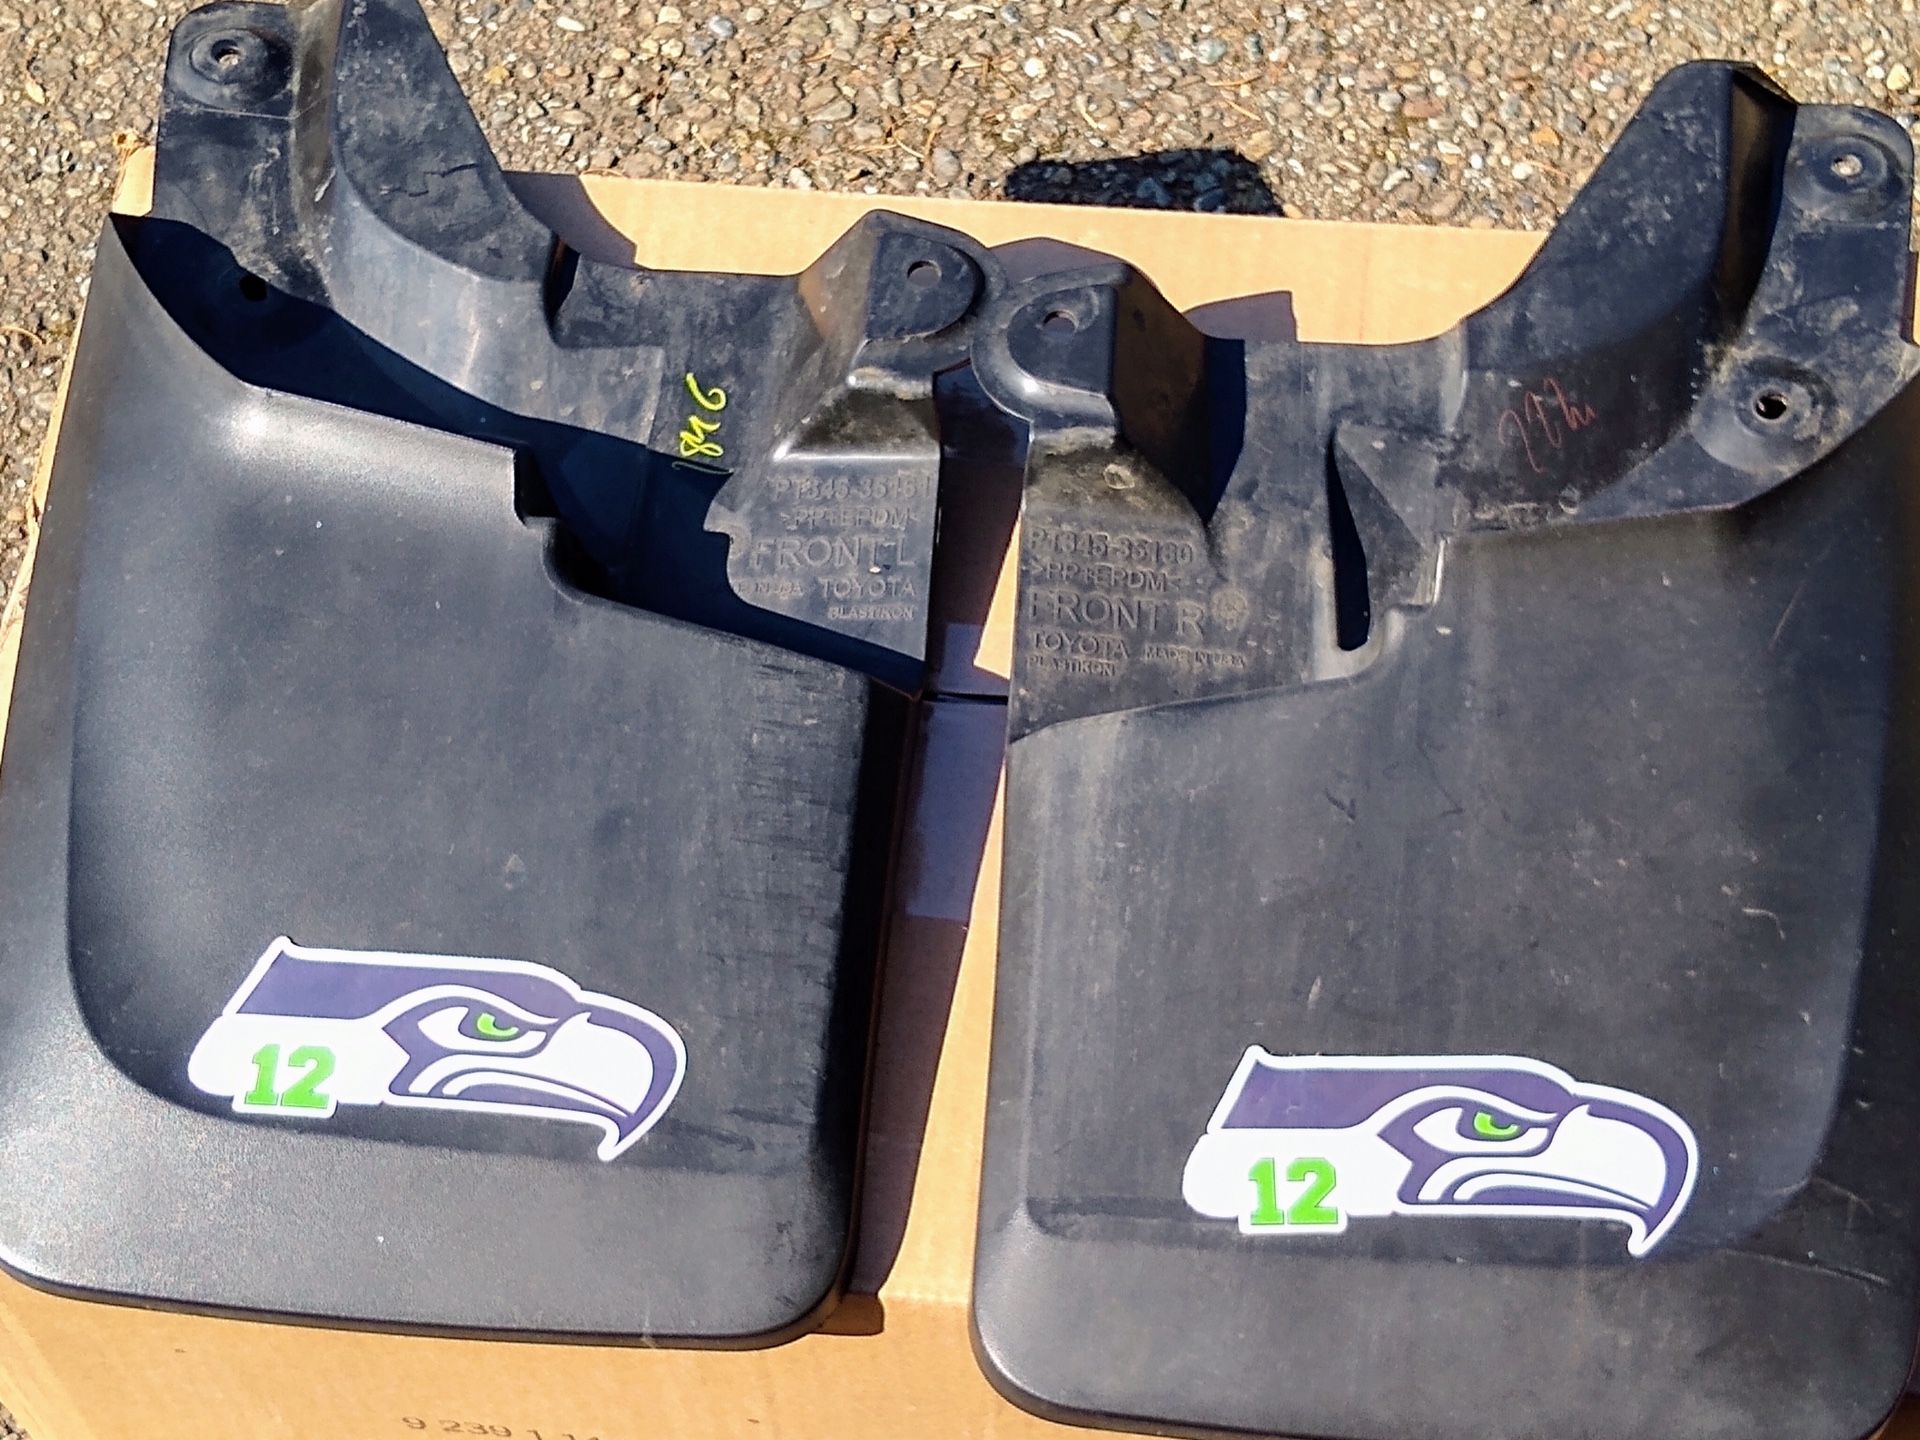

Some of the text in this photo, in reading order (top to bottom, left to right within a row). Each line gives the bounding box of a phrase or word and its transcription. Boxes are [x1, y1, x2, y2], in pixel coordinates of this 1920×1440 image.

[753, 534, 916, 569] FRONT L
[818, 576, 916, 599] TOYOTA
[1028, 586, 1206, 640] FRONT R
[1032, 631, 1130, 660] TOYOTA
[244, 1043, 336, 1109] 12
[1247, 1156, 1338, 1226] 12
[402, 1416, 427, 1430] 9
